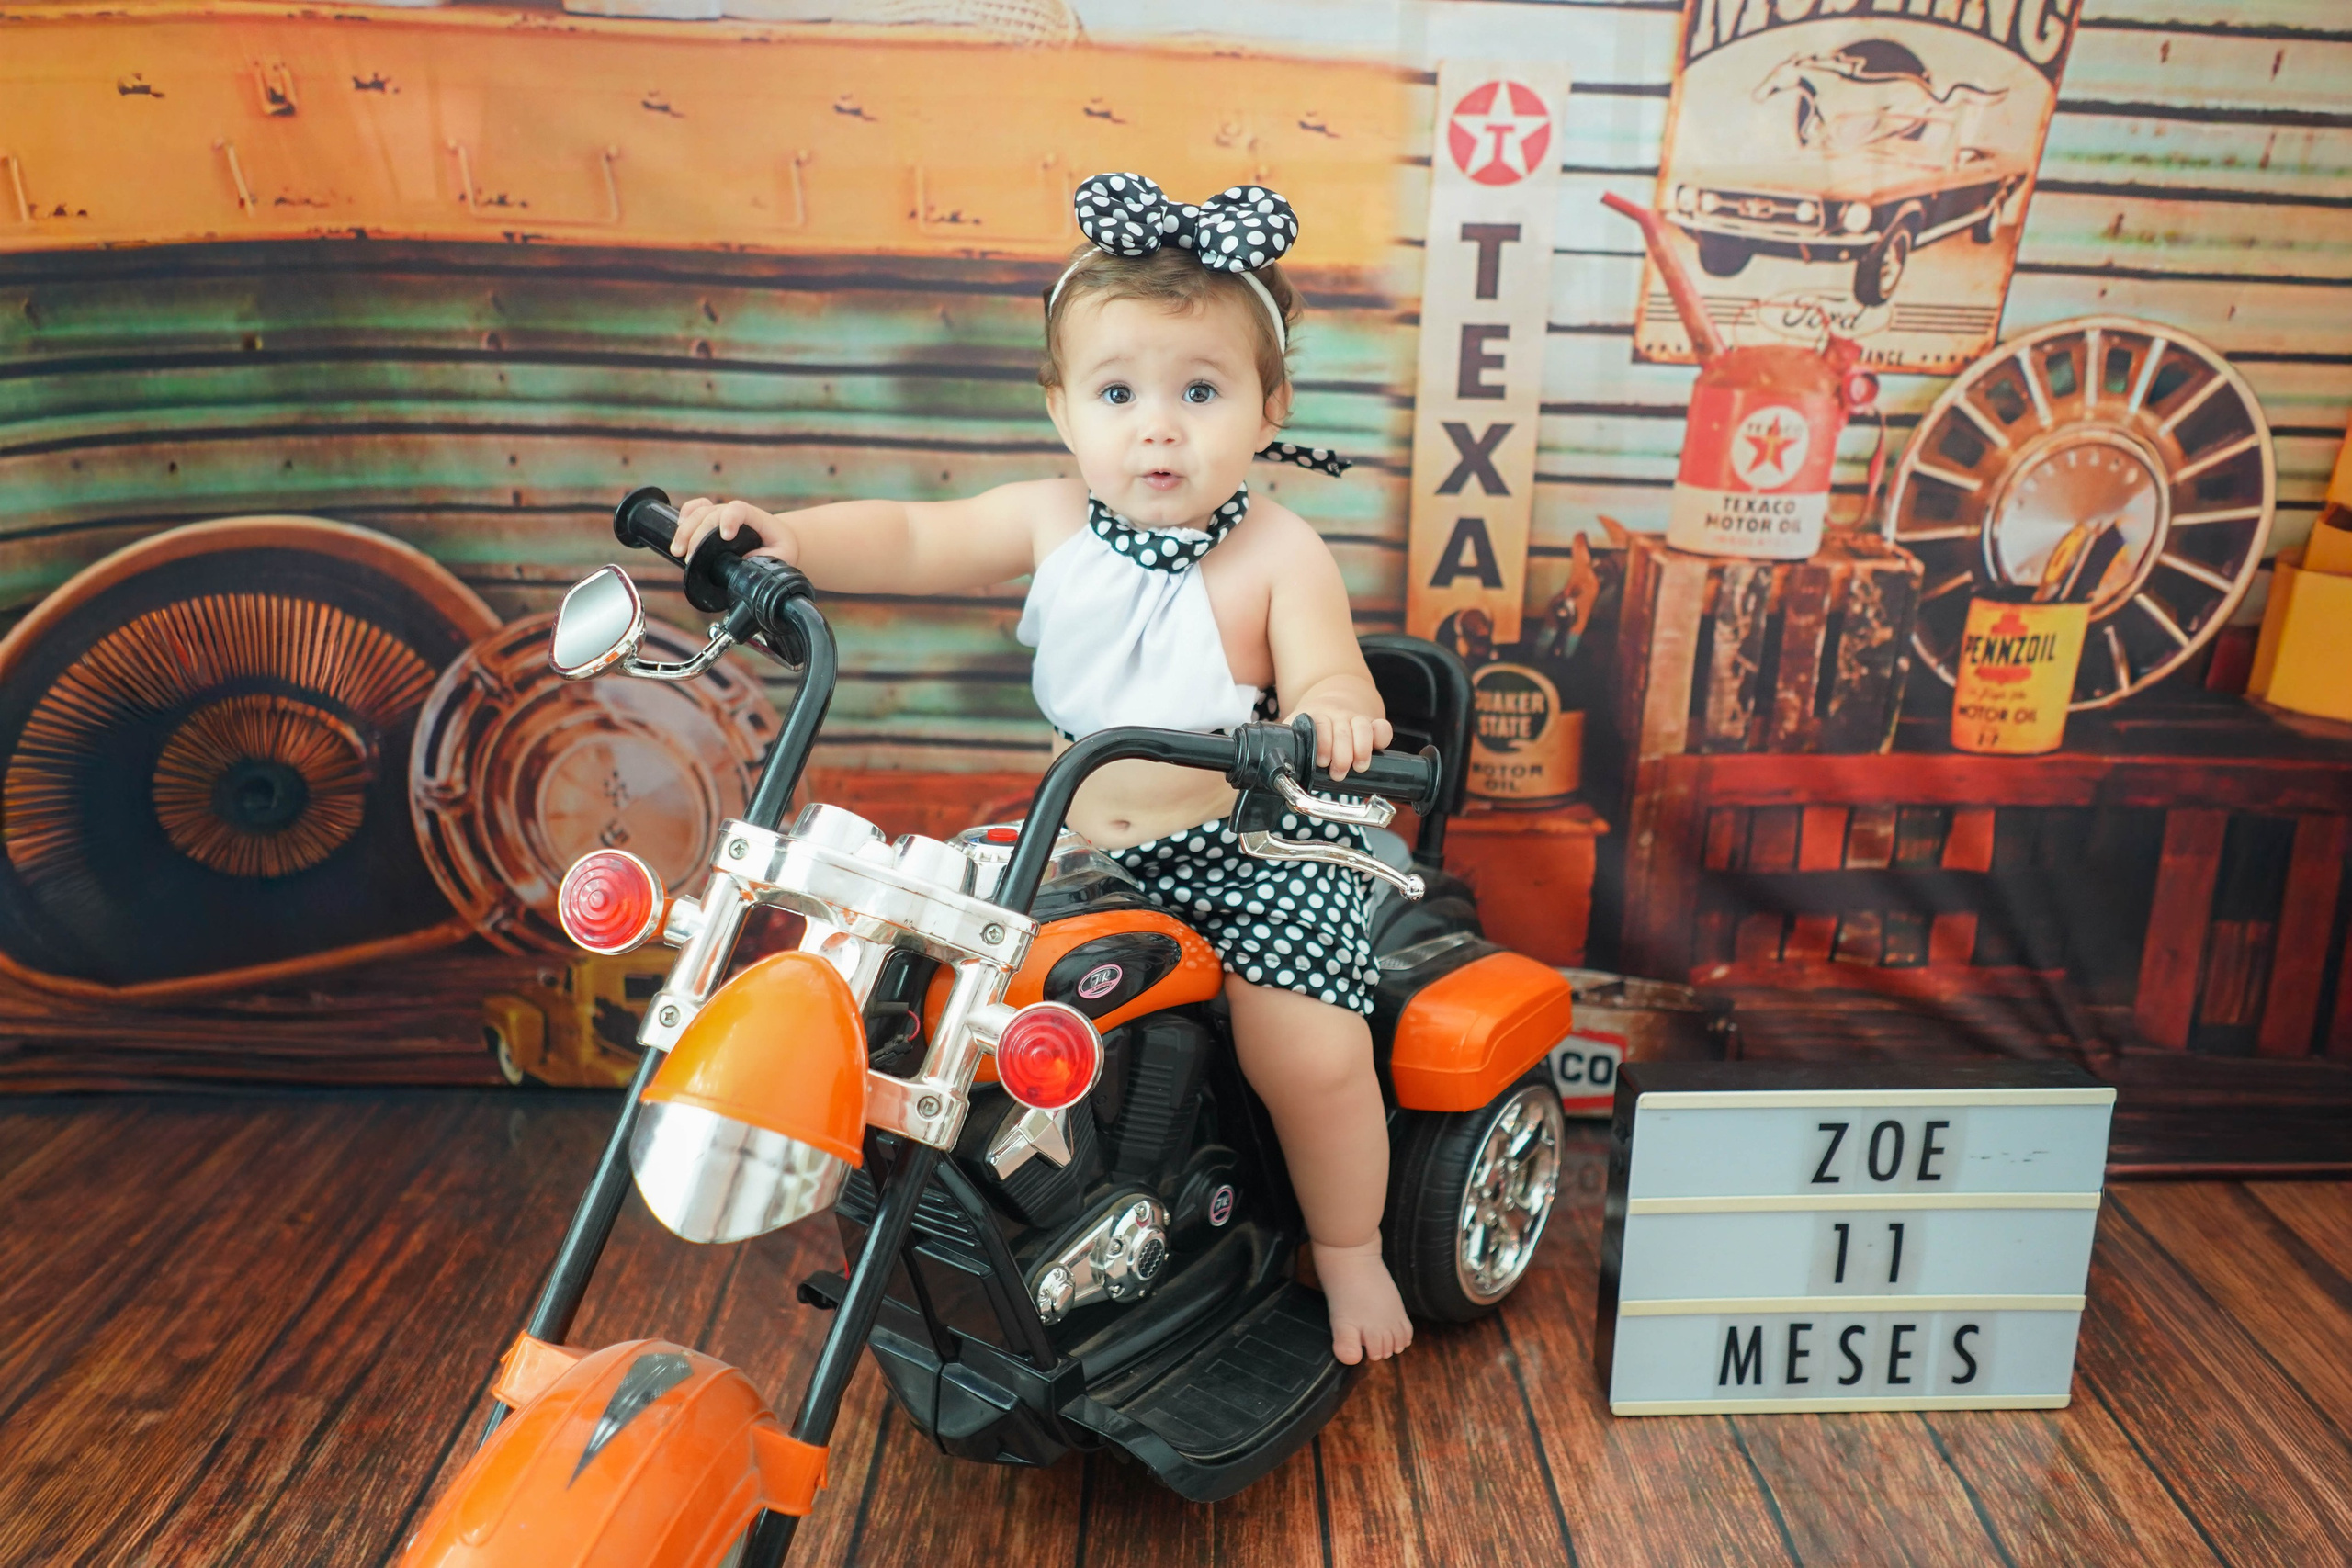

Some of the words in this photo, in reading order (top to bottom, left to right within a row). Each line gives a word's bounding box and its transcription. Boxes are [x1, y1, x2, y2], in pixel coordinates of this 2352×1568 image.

[1690, 0, 2076, 64] MANG
[1781, 294, 1867, 331] Ford
[1428, 222, 1522, 637] TEXA
[1724, 496, 1796, 515] TEXACO
[1706, 513, 1772, 534] MOTOR
[1965, 633, 2056, 665] PENNZOIL
[1478, 714, 1532, 739] STATE
[1959, 703, 2008, 722] MOTOR
[1473, 764, 1544, 778] MOTOR
[1485, 779, 1519, 792] OIL
[1548, 1051, 1614, 1086] CO
[1810, 1120, 1951, 1184] ZOE
[1832, 1222, 1905, 1284] 11
[1718, 1323, 1980, 1386] MESES
